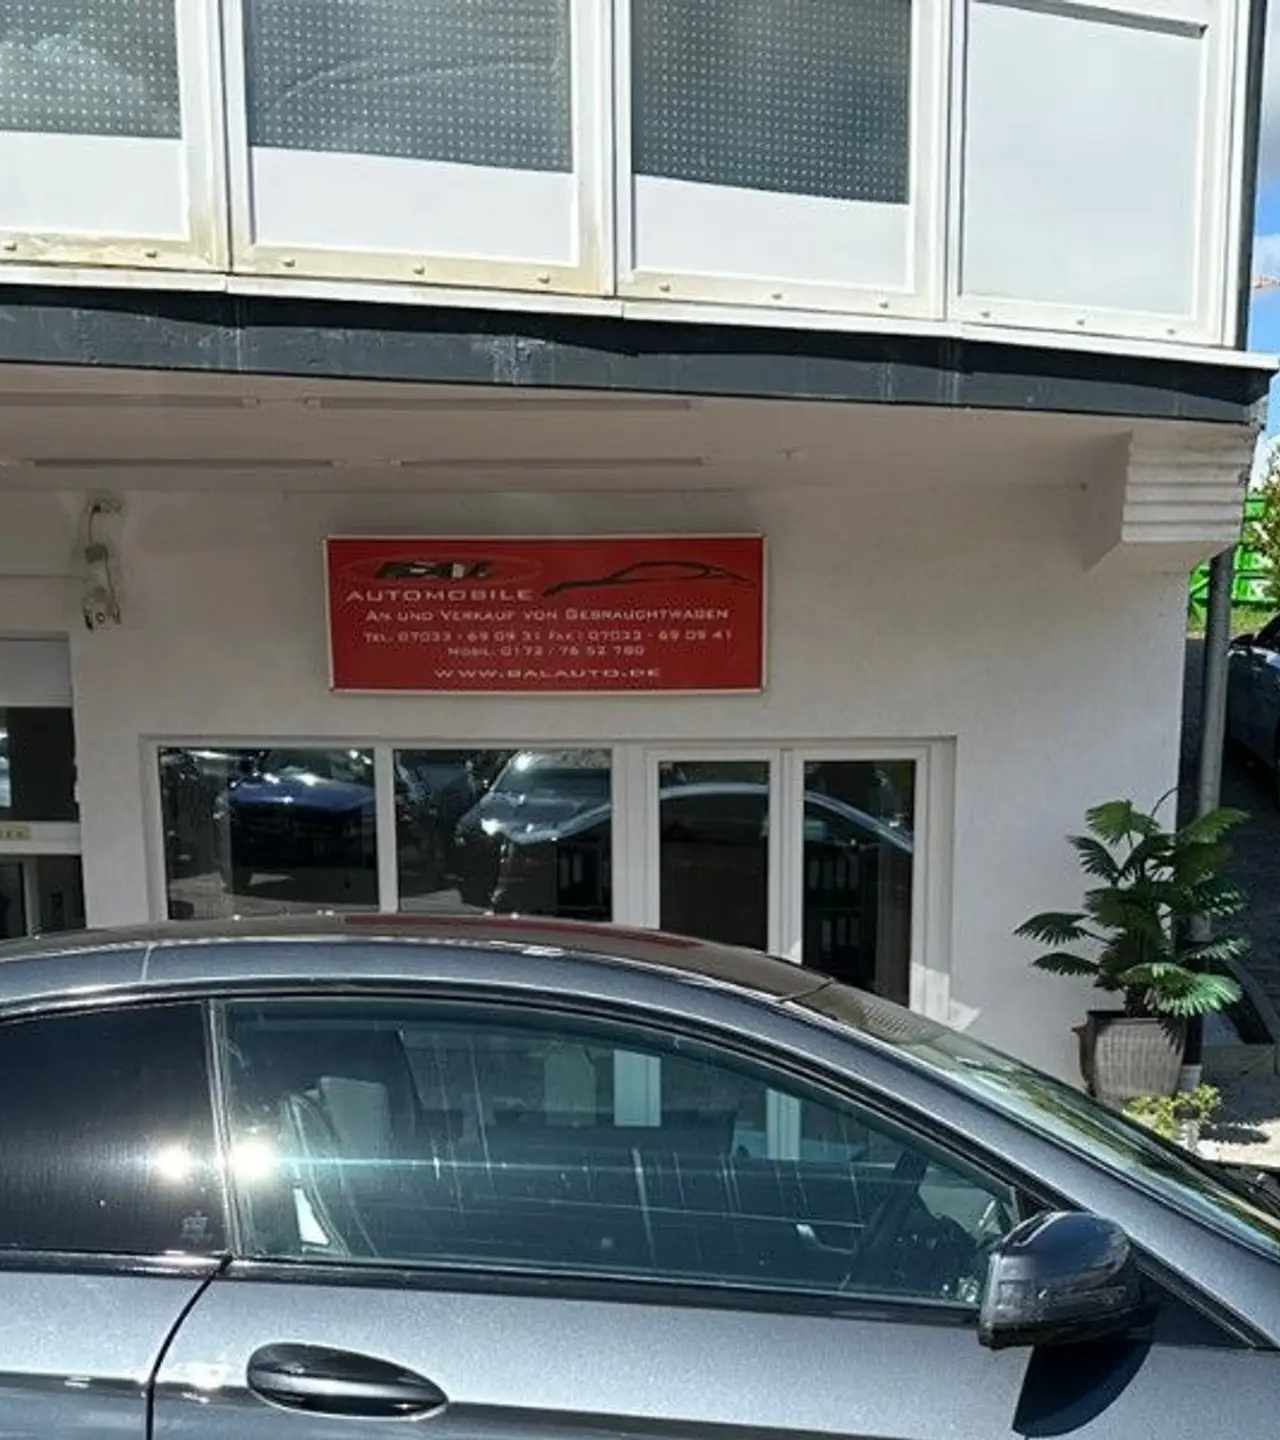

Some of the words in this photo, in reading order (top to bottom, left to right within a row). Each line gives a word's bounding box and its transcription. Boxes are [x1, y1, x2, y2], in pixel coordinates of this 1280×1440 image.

[346, 589, 533, 601] AUTOMOBILE
[397, 610, 434, 621] UND
[440, 610, 517, 621] VERKAUF
[524, 609, 558, 621] VON
[565, 608, 729, 621] GEBRAUCHTWAGEN
